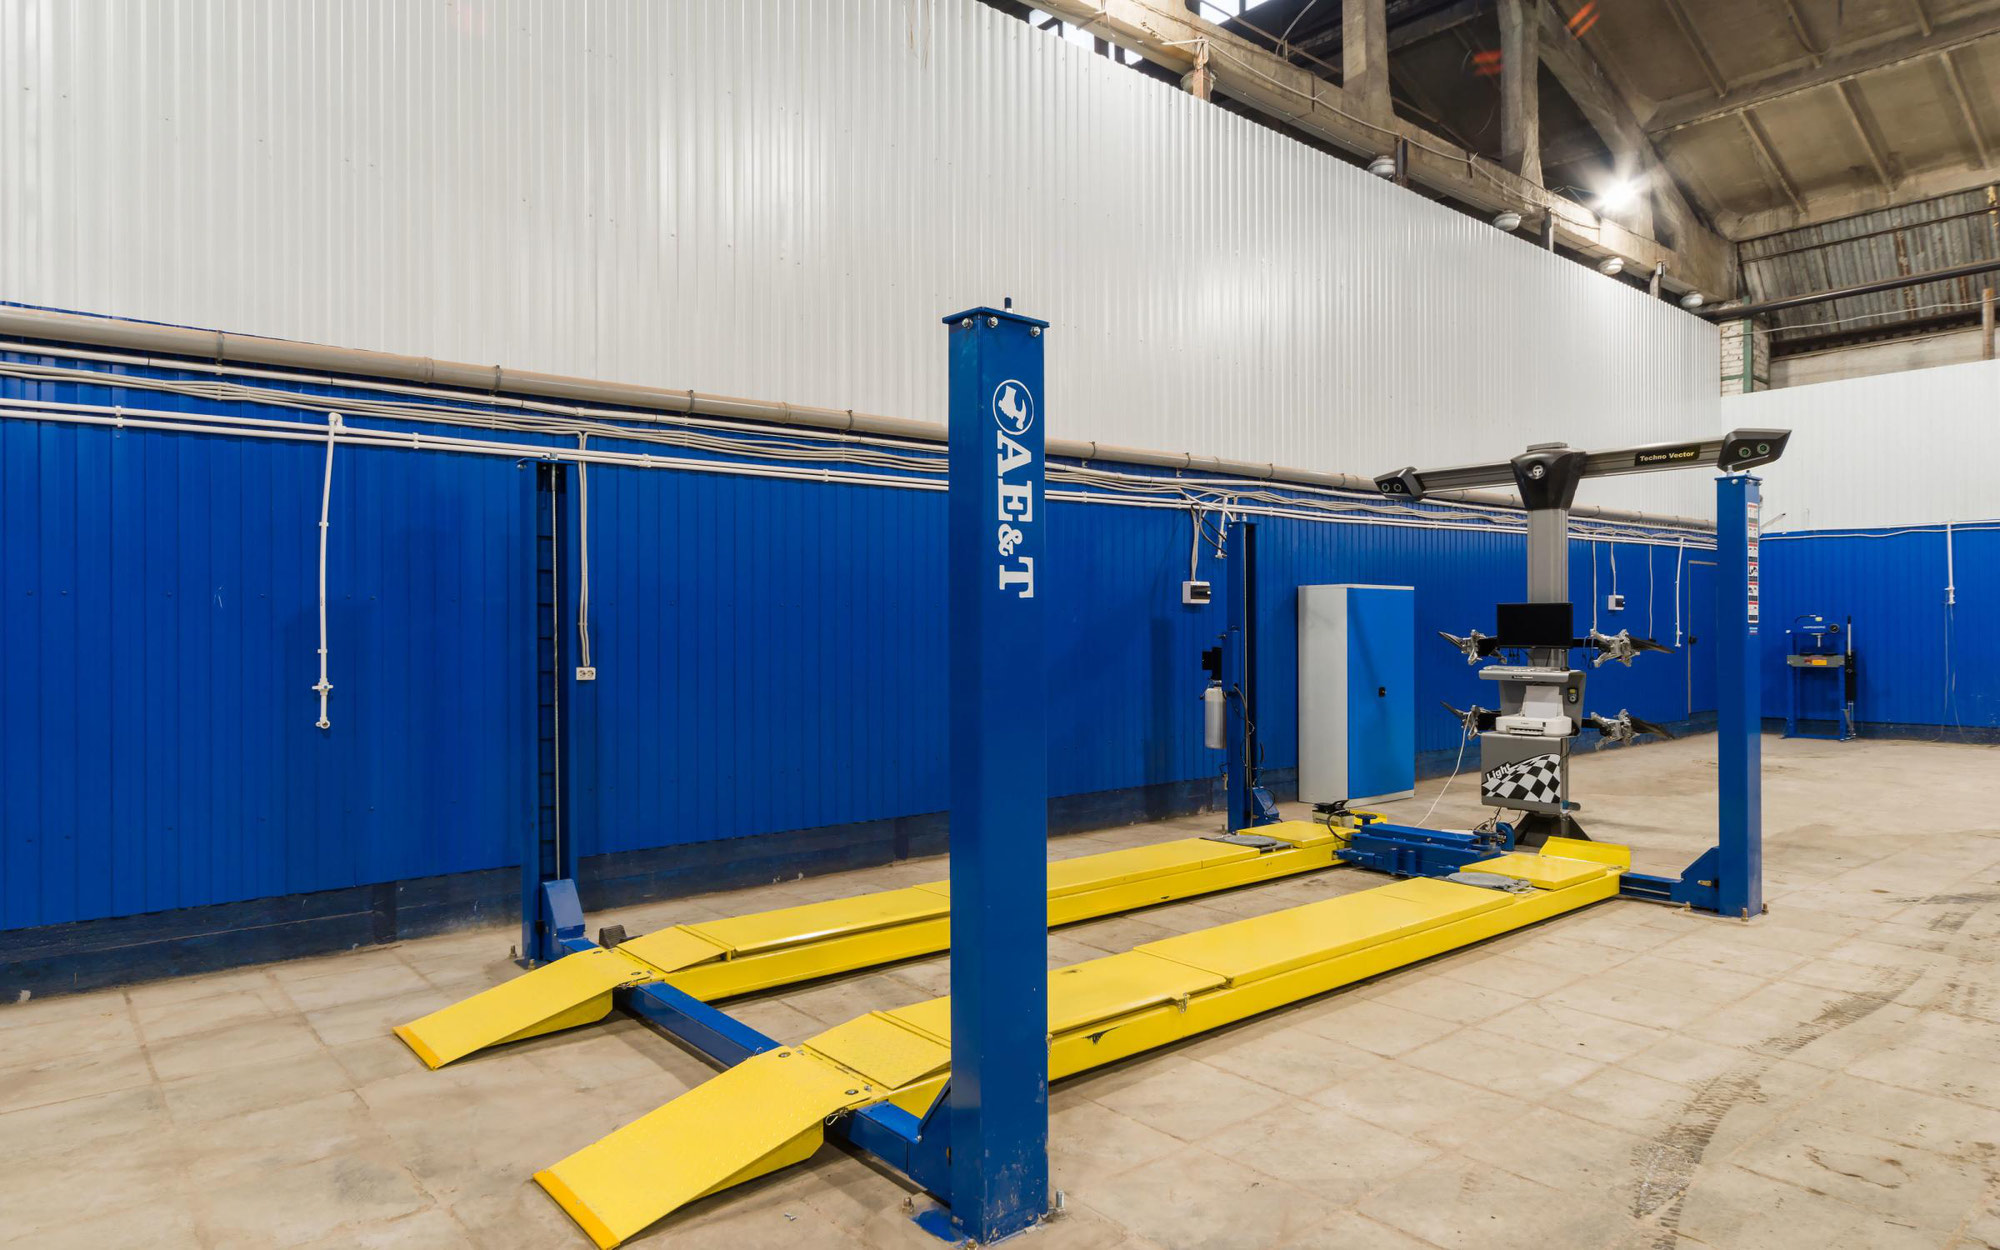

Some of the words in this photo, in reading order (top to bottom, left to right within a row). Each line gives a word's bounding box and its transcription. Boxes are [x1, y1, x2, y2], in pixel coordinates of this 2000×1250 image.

[1640, 454, 1667, 462] Techno
[1669, 451, 1695, 459] Vector
[997, 430, 1034, 598] AE&T
[1486, 763, 1511, 782] Light
